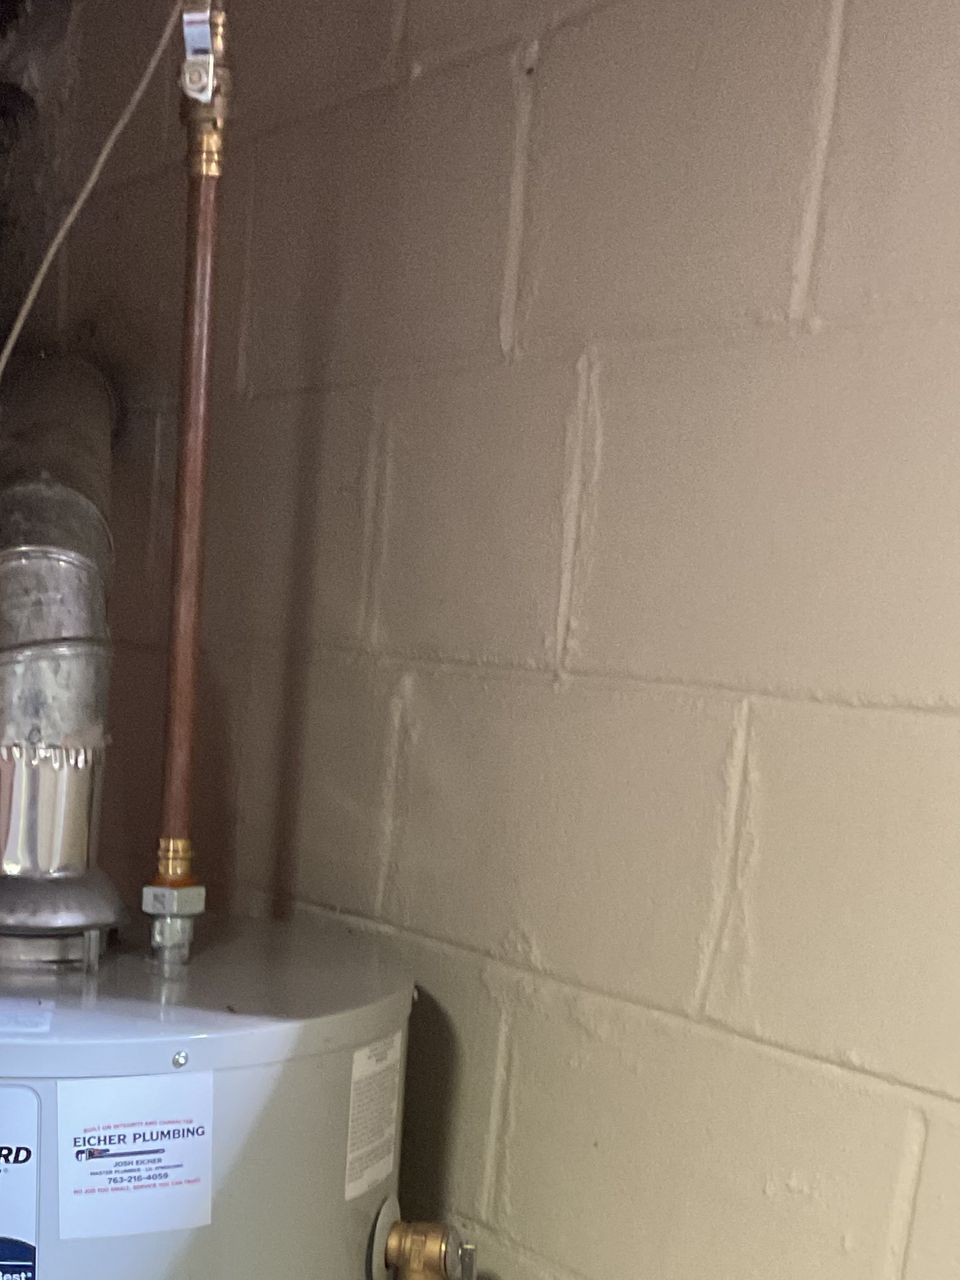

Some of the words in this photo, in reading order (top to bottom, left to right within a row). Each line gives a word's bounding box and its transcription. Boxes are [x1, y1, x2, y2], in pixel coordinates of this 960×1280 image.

[73, 1133, 127, 1148] EICHER
[132, 1126, 205, 1144] PLUMBING
[113, 1160, 134, 1168] JOSH
[136, 1157, 162, 1166] EICHER
